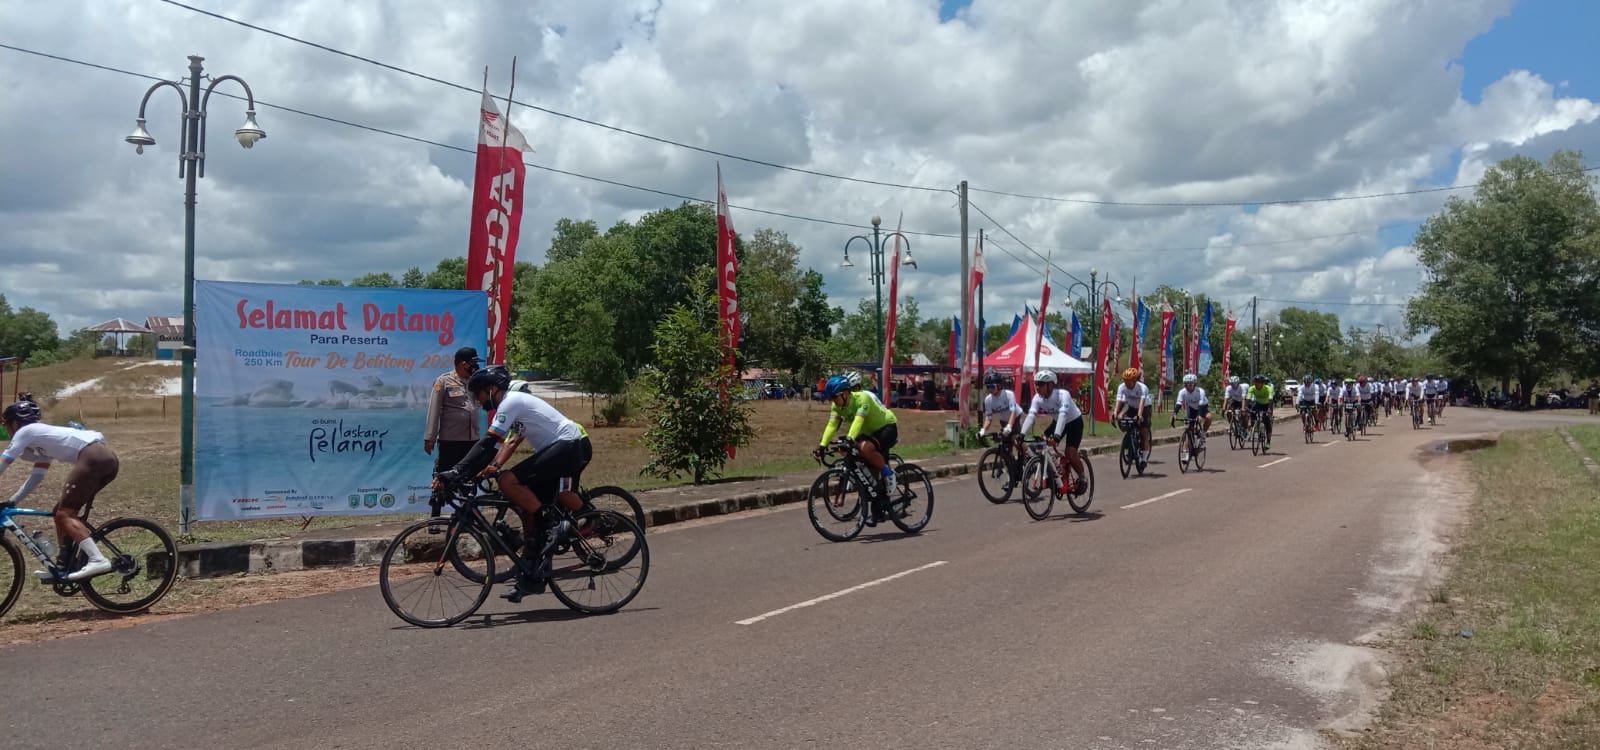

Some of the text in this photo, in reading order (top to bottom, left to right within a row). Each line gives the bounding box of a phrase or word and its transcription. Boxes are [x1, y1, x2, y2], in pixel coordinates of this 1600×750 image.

[236, 299, 455, 346] Selamat Datang
[310, 334, 388, 346] Para Peserta
[235, 348, 283, 358] Roadbike
[244, 358, 283, 367] 250 Km
[283, 351, 320, 369] Tour
[325, 351, 348, 370] De
[353, 352, 416, 372] Belitong
[339, 419, 379, 438] laskar
[309, 427, 389, 463] Pelangi
